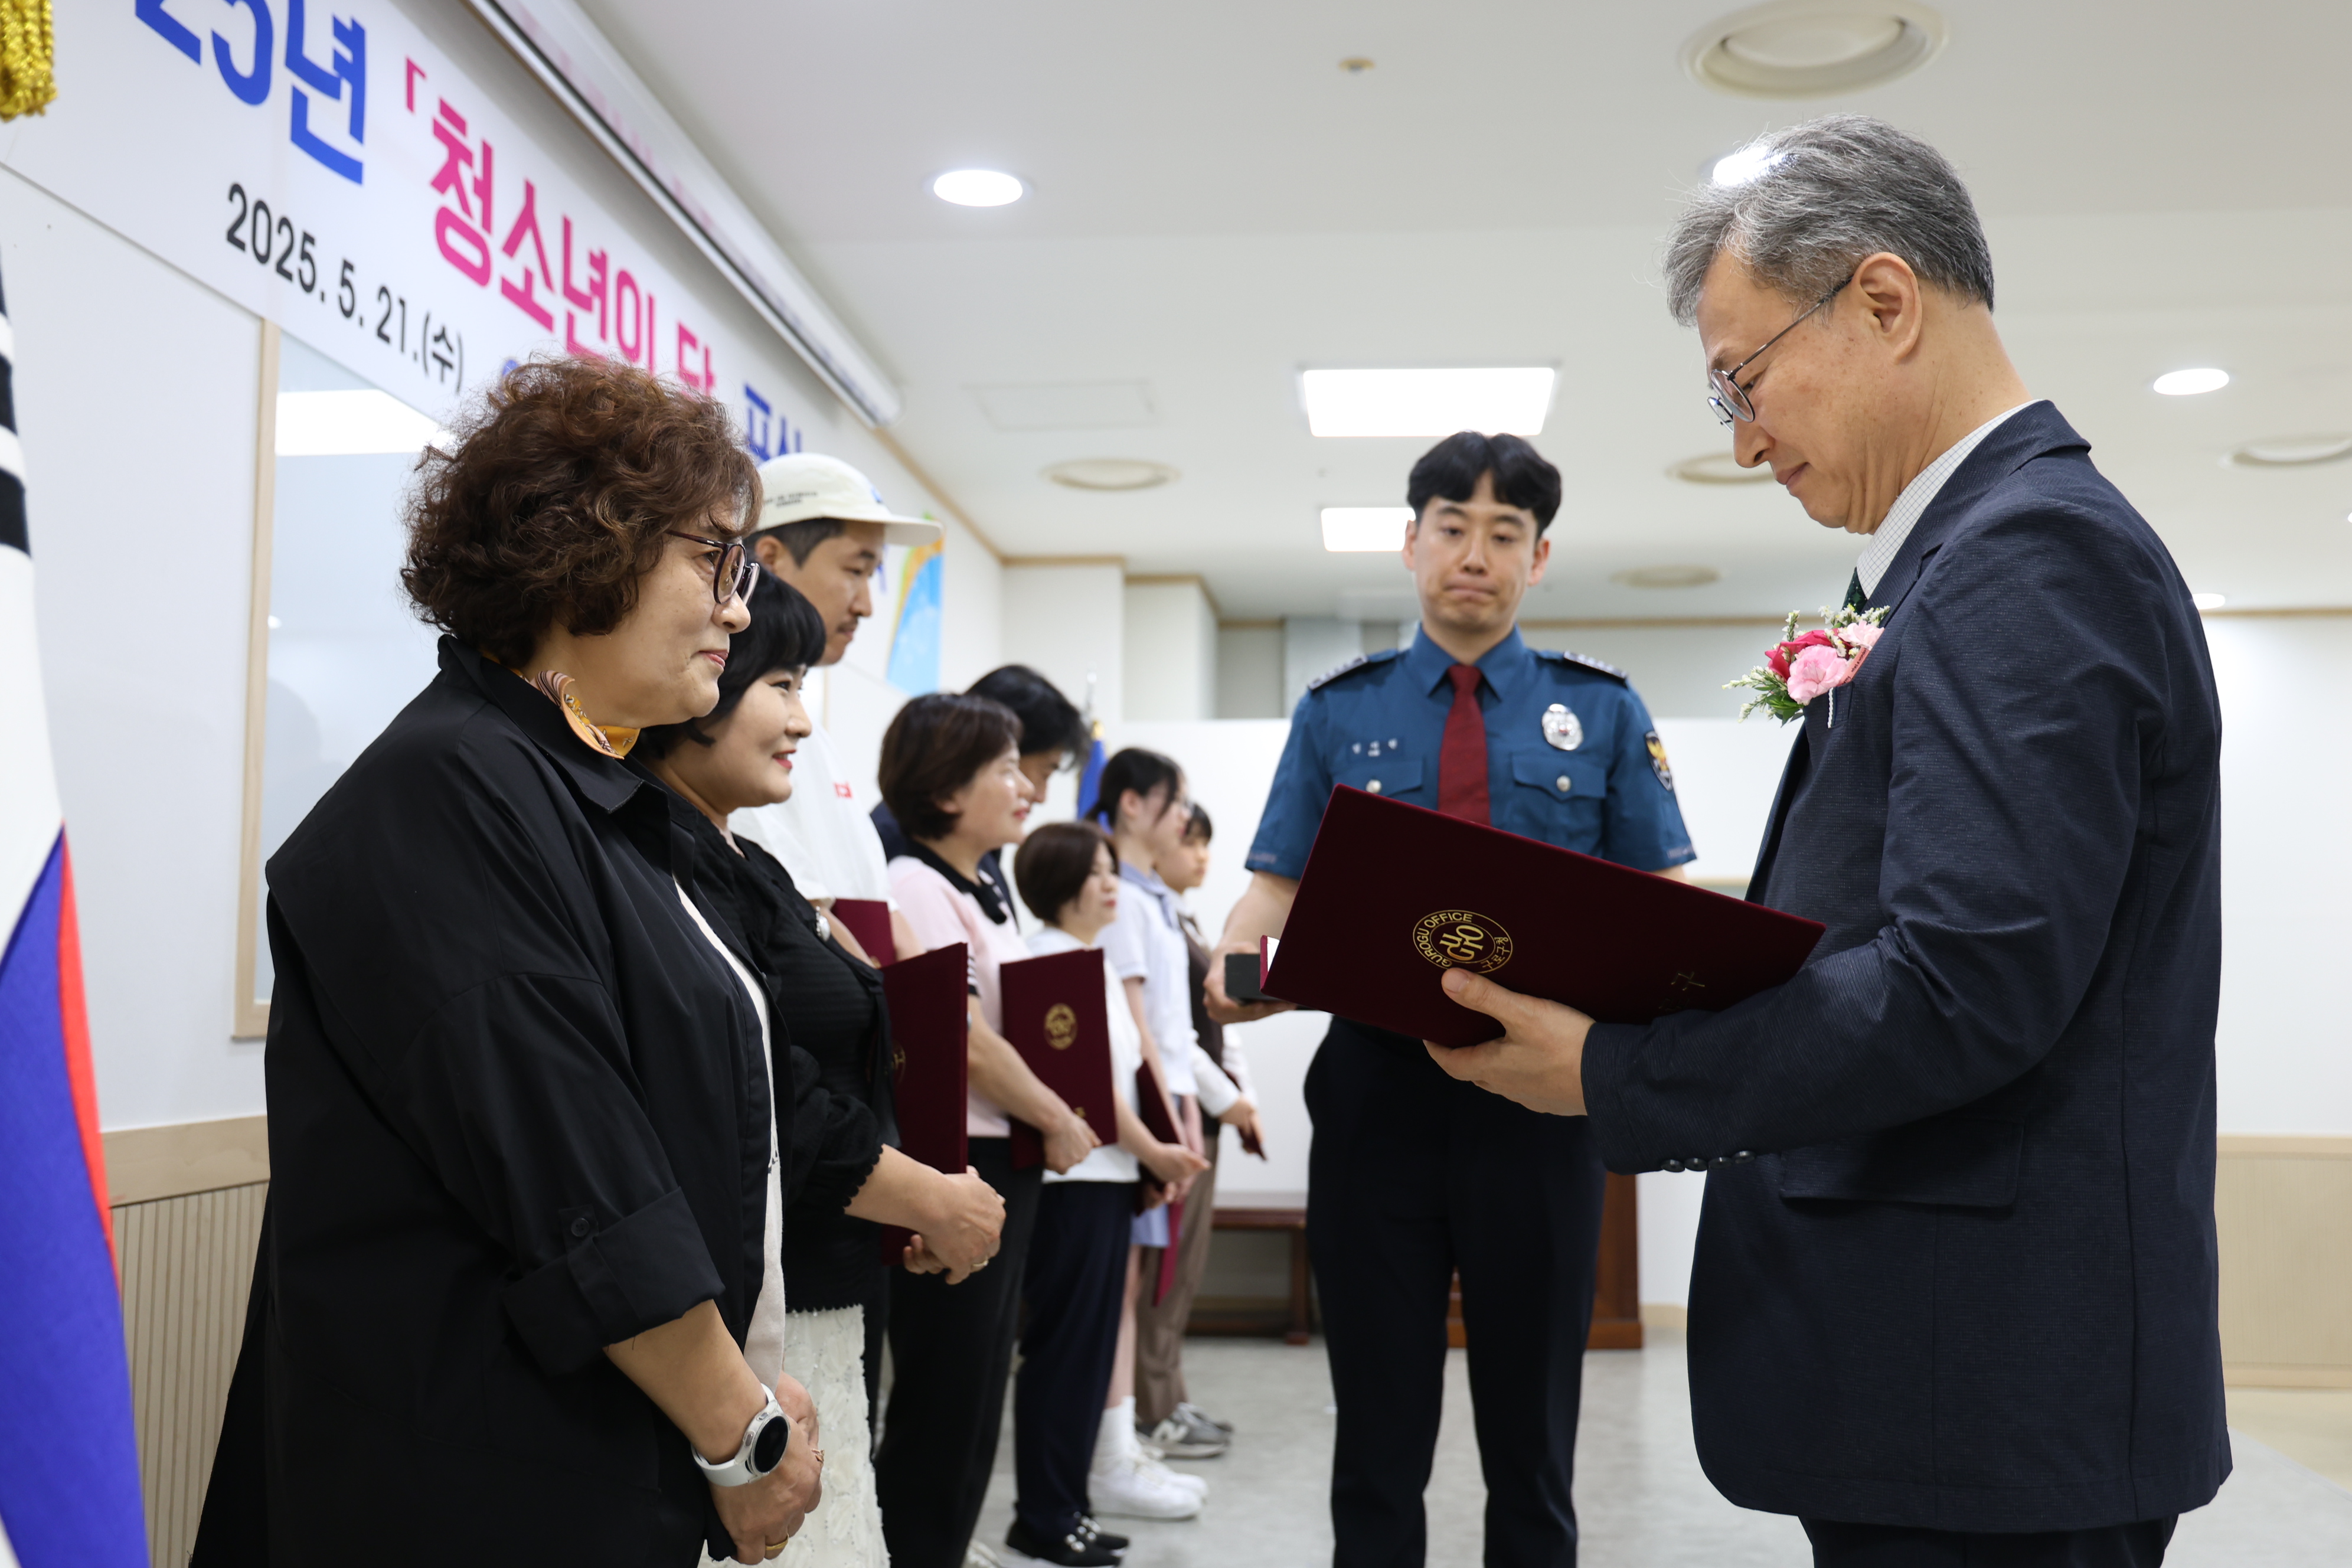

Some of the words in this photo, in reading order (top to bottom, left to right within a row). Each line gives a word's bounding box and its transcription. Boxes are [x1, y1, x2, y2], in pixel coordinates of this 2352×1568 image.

[135, 0, 365, 186] 5년
[1423, 912, 1474, 929] OFFICE
[1416, 927, 1453, 968] GUROGU
[1480, 936, 1510, 969] 구로구청
